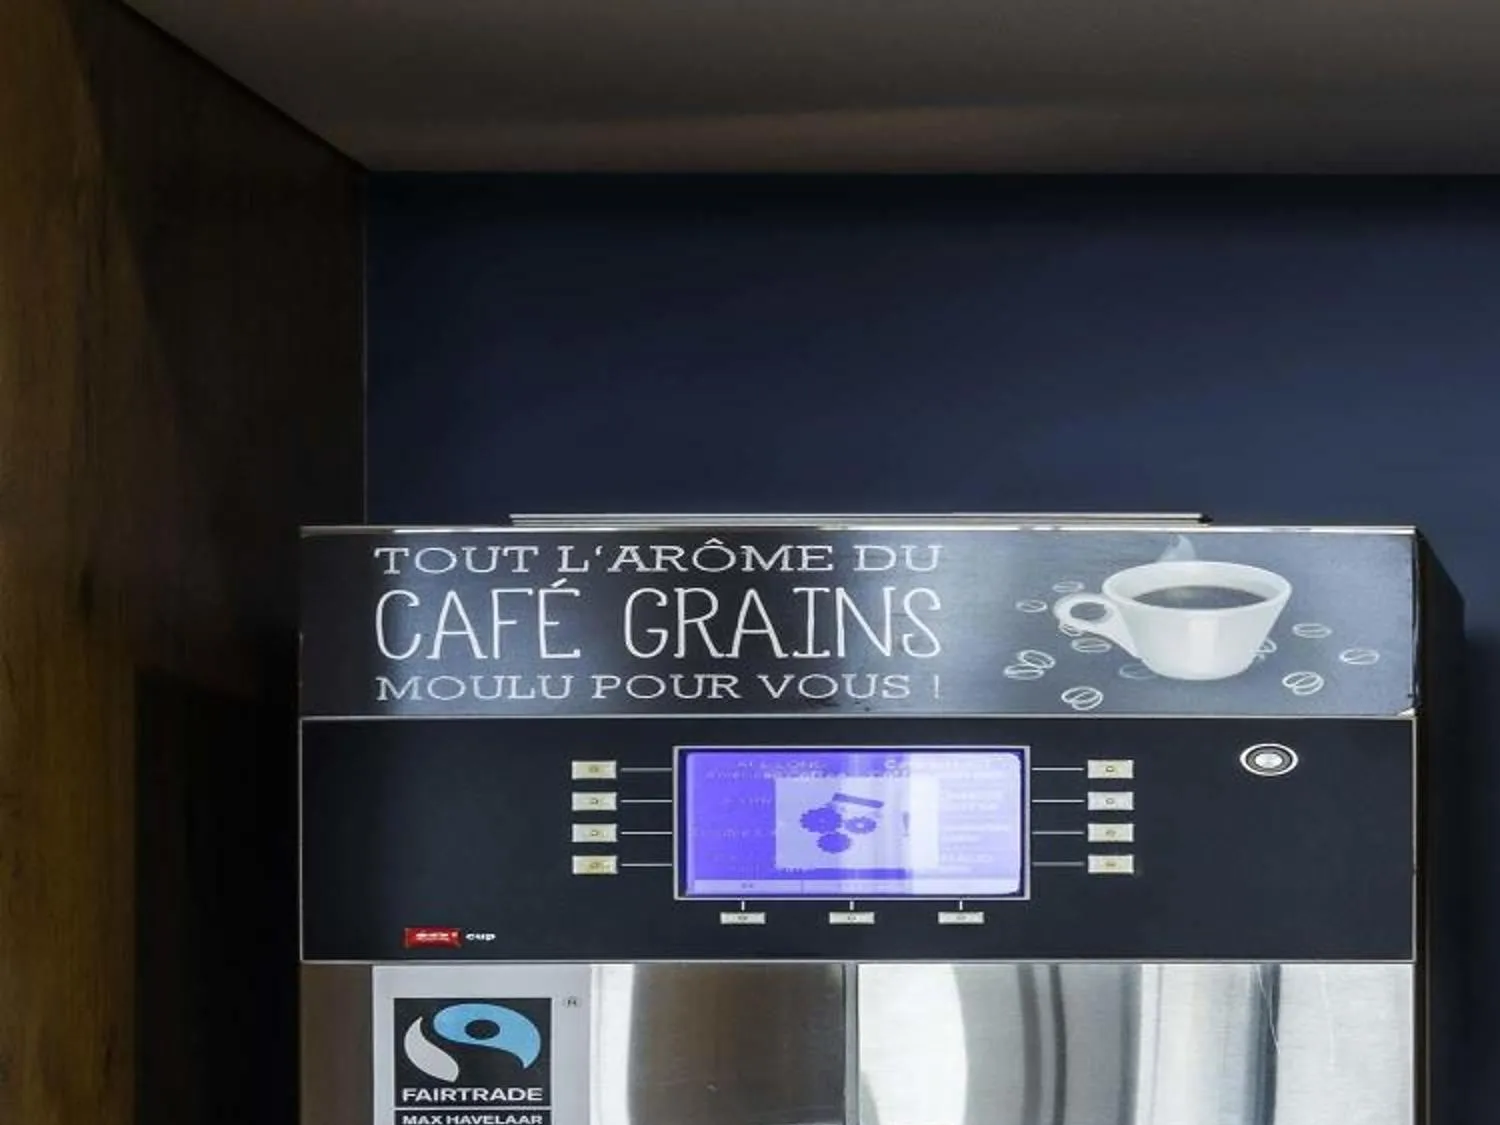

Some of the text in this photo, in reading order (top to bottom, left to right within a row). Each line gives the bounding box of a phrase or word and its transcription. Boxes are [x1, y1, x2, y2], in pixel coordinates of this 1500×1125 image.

[374, 537, 943, 575] TOUT L'ARÔME DU
[375, 578, 942, 661] CAFÉ GRAINS
[375, 674, 575, 702] MOULU
[591, 673, 743, 700] POUR
[757, 673, 911, 700] VOUS
[402, 1086, 543, 1102] FAIRTRADE
[402, 1115, 543, 1125] MAX HAVELAAR
